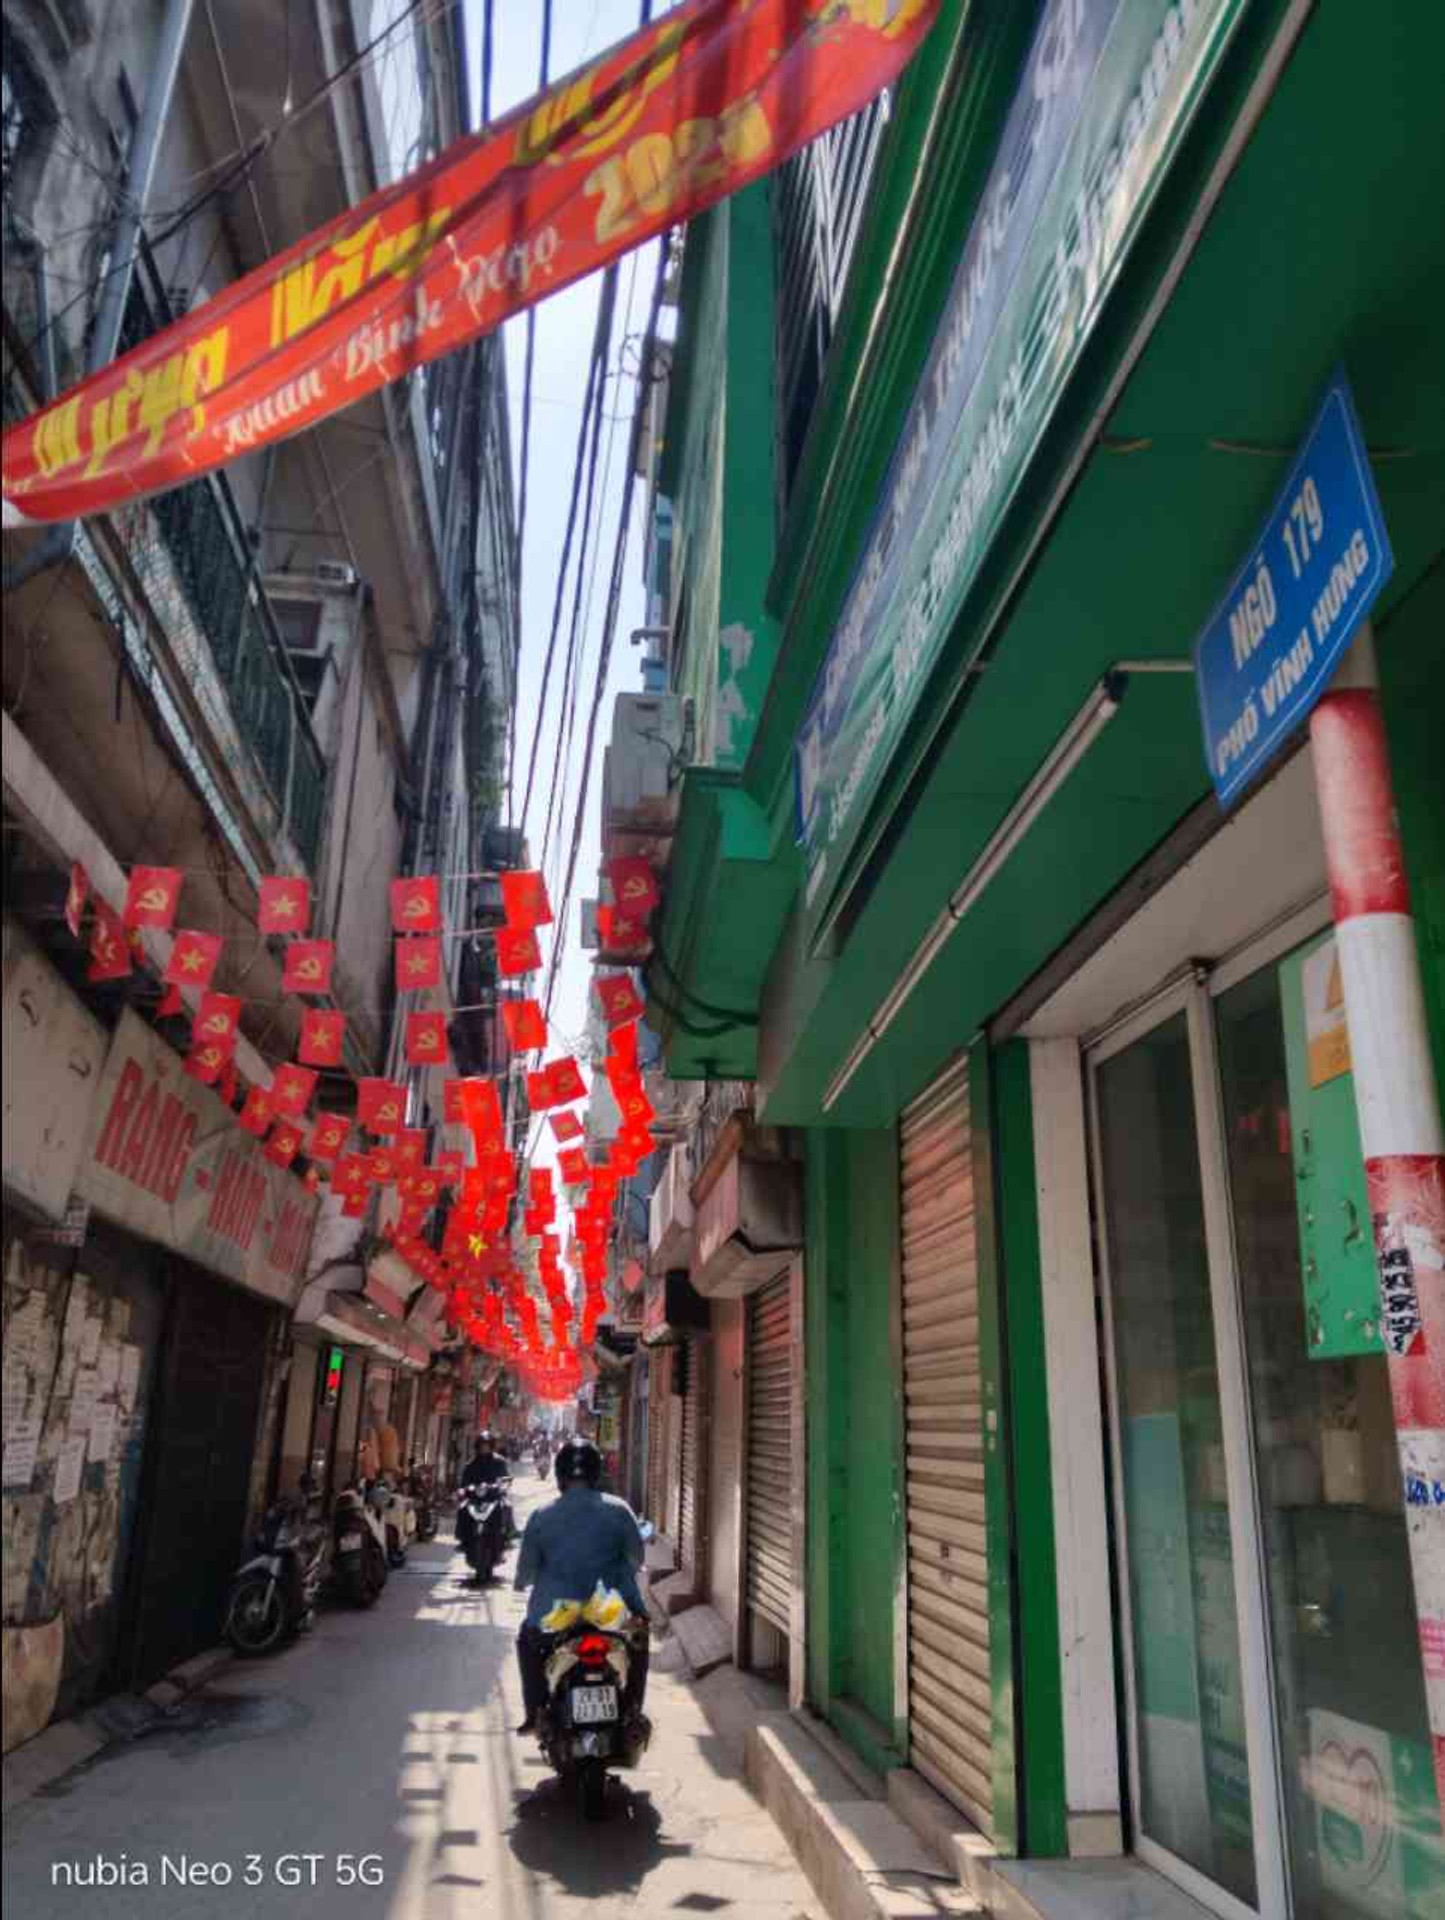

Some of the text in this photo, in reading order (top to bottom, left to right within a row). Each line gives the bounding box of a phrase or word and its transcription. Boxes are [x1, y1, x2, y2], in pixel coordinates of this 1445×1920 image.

[1283, 476, 1323, 578] 179
[1217, 688, 1258, 777] PHỐ
[1260, 627, 1313, 718] VĨNH
